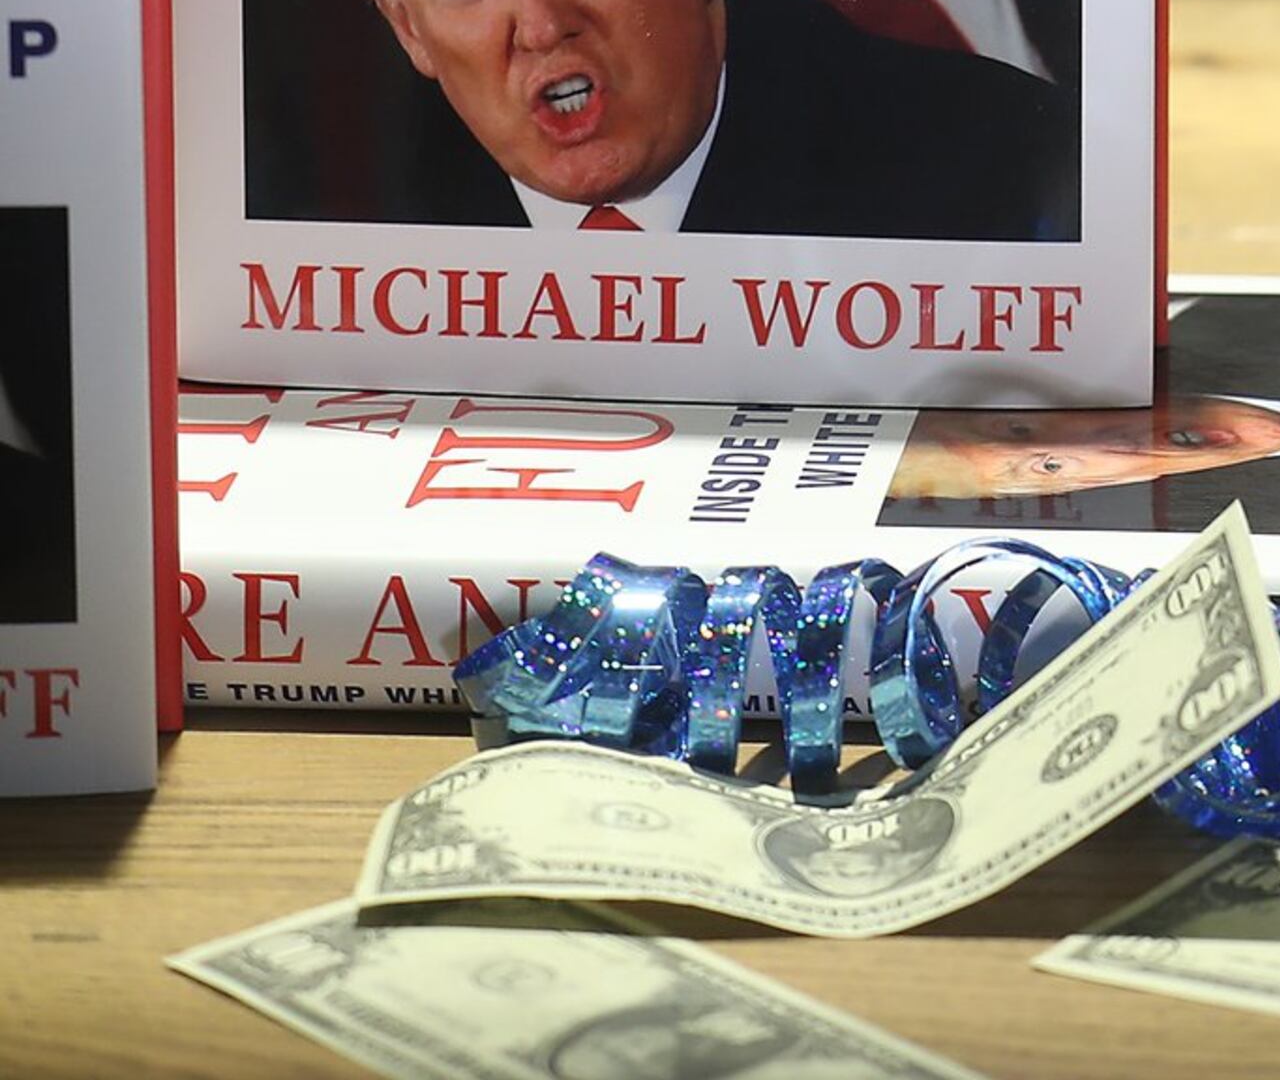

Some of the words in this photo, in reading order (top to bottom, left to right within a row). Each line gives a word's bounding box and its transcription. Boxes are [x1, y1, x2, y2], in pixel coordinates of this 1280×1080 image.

[240, 262, 707, 345] MICHAEL
[738, 278, 1083, 353] WOLFF
[305, 392, 416, 439] AN
[795, 412, 883, 489] WHITE
[405, 398, 676, 512] FU
[689, 436, 780, 523] INSIDE
[180, 571, 304, 665] RE
[346, 575, 572, 668] AN
[226, 683, 366, 704] TRUMP
[385, 687, 460, 706] WHI
[387, 841, 478, 876] 100
[827, 812, 901, 850] 100
